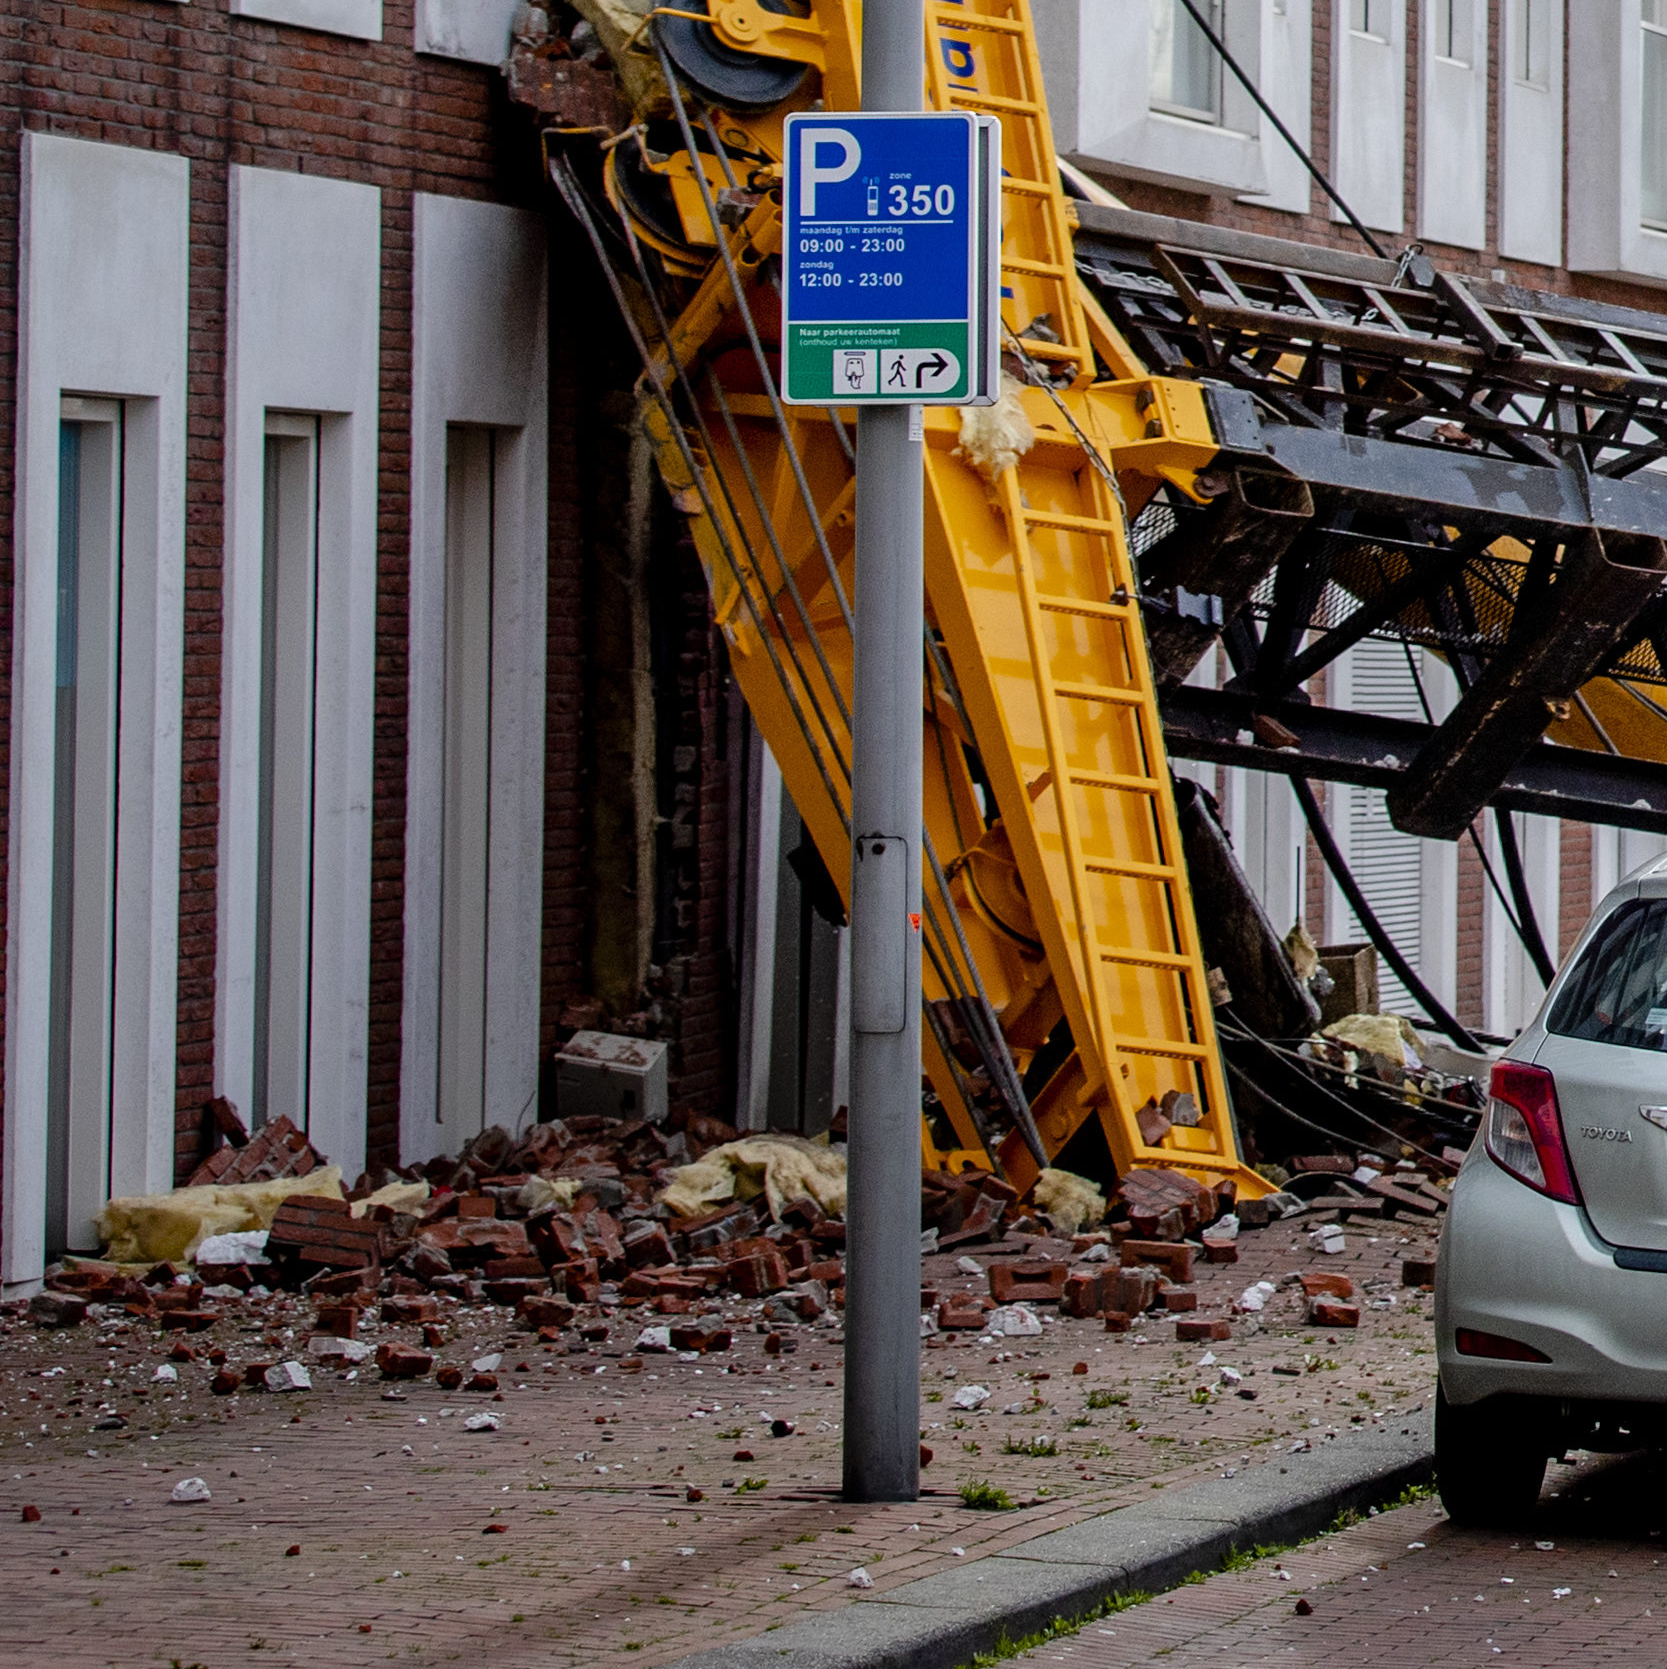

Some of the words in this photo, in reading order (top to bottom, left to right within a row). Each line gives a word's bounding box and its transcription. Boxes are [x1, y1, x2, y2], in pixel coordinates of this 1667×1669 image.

[800, 128, 862, 217] P
[889, 172, 912, 180] zone
[888, 184, 955, 216] 350
[800, 227, 842, 236] maandag
[863, 226, 903, 235] zaterdag
[800, 239, 844, 252] 09:00
[861, 238, 905, 252] 23:00
[800, 261, 834, 270] zondag
[800, 273, 841, 287] 12:00
[859, 273, 903, 286] 23:00
[823, 328, 900, 337] parkeerautomaat
[1581, 1126, 1633, 1144] TOYOTA
